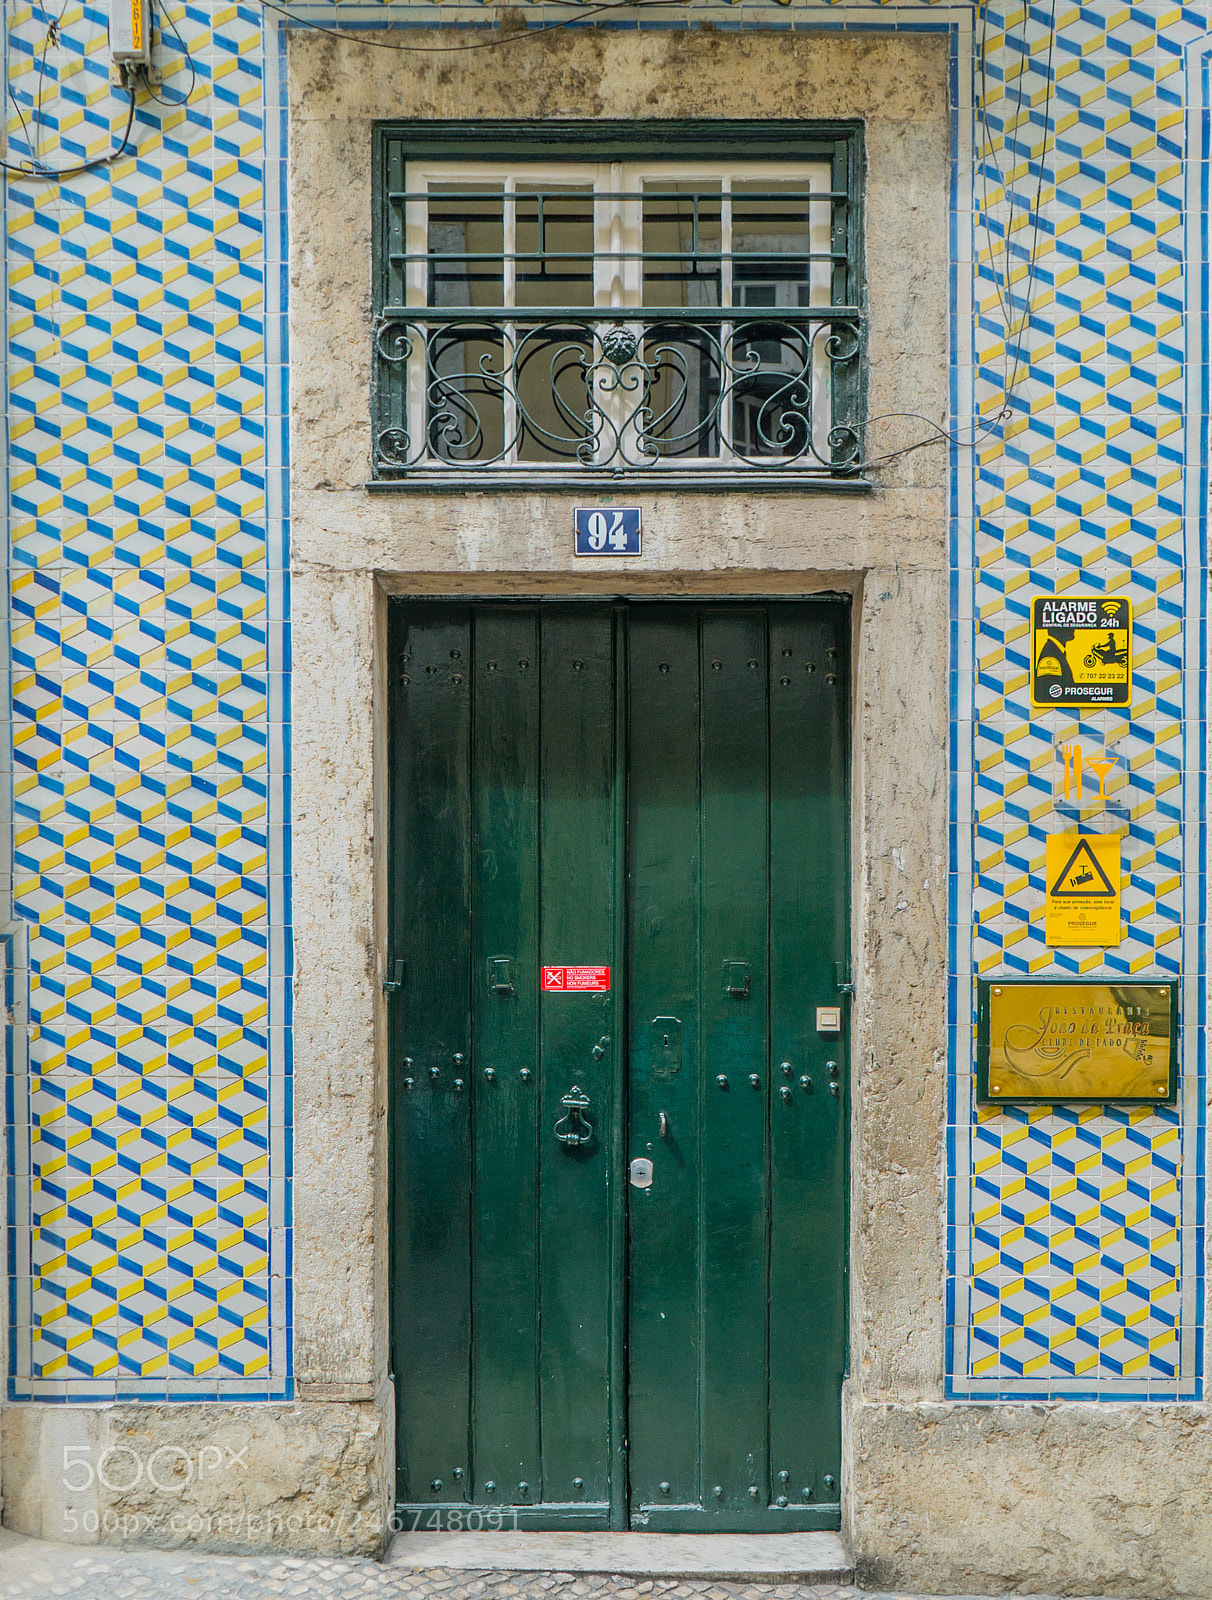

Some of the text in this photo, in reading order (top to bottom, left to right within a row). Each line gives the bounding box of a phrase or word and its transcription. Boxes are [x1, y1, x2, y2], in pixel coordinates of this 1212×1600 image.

[587, 511, 628, 551] 94
[1042, 601, 1097, 612] ALARME
[1042, 612, 1098, 624] LIGADO
[1100, 618, 1120, 628] 24h
[1064, 687, 1113, 695] PROSEGUR
[1055, 1006, 1151, 1016] RESTAURANTE
[1081, 1019, 1099, 1035] da
[1105, 1018, 1150, 1038] Praça
[1042, 1037, 1122, 1047] CLUBE DE FADO
